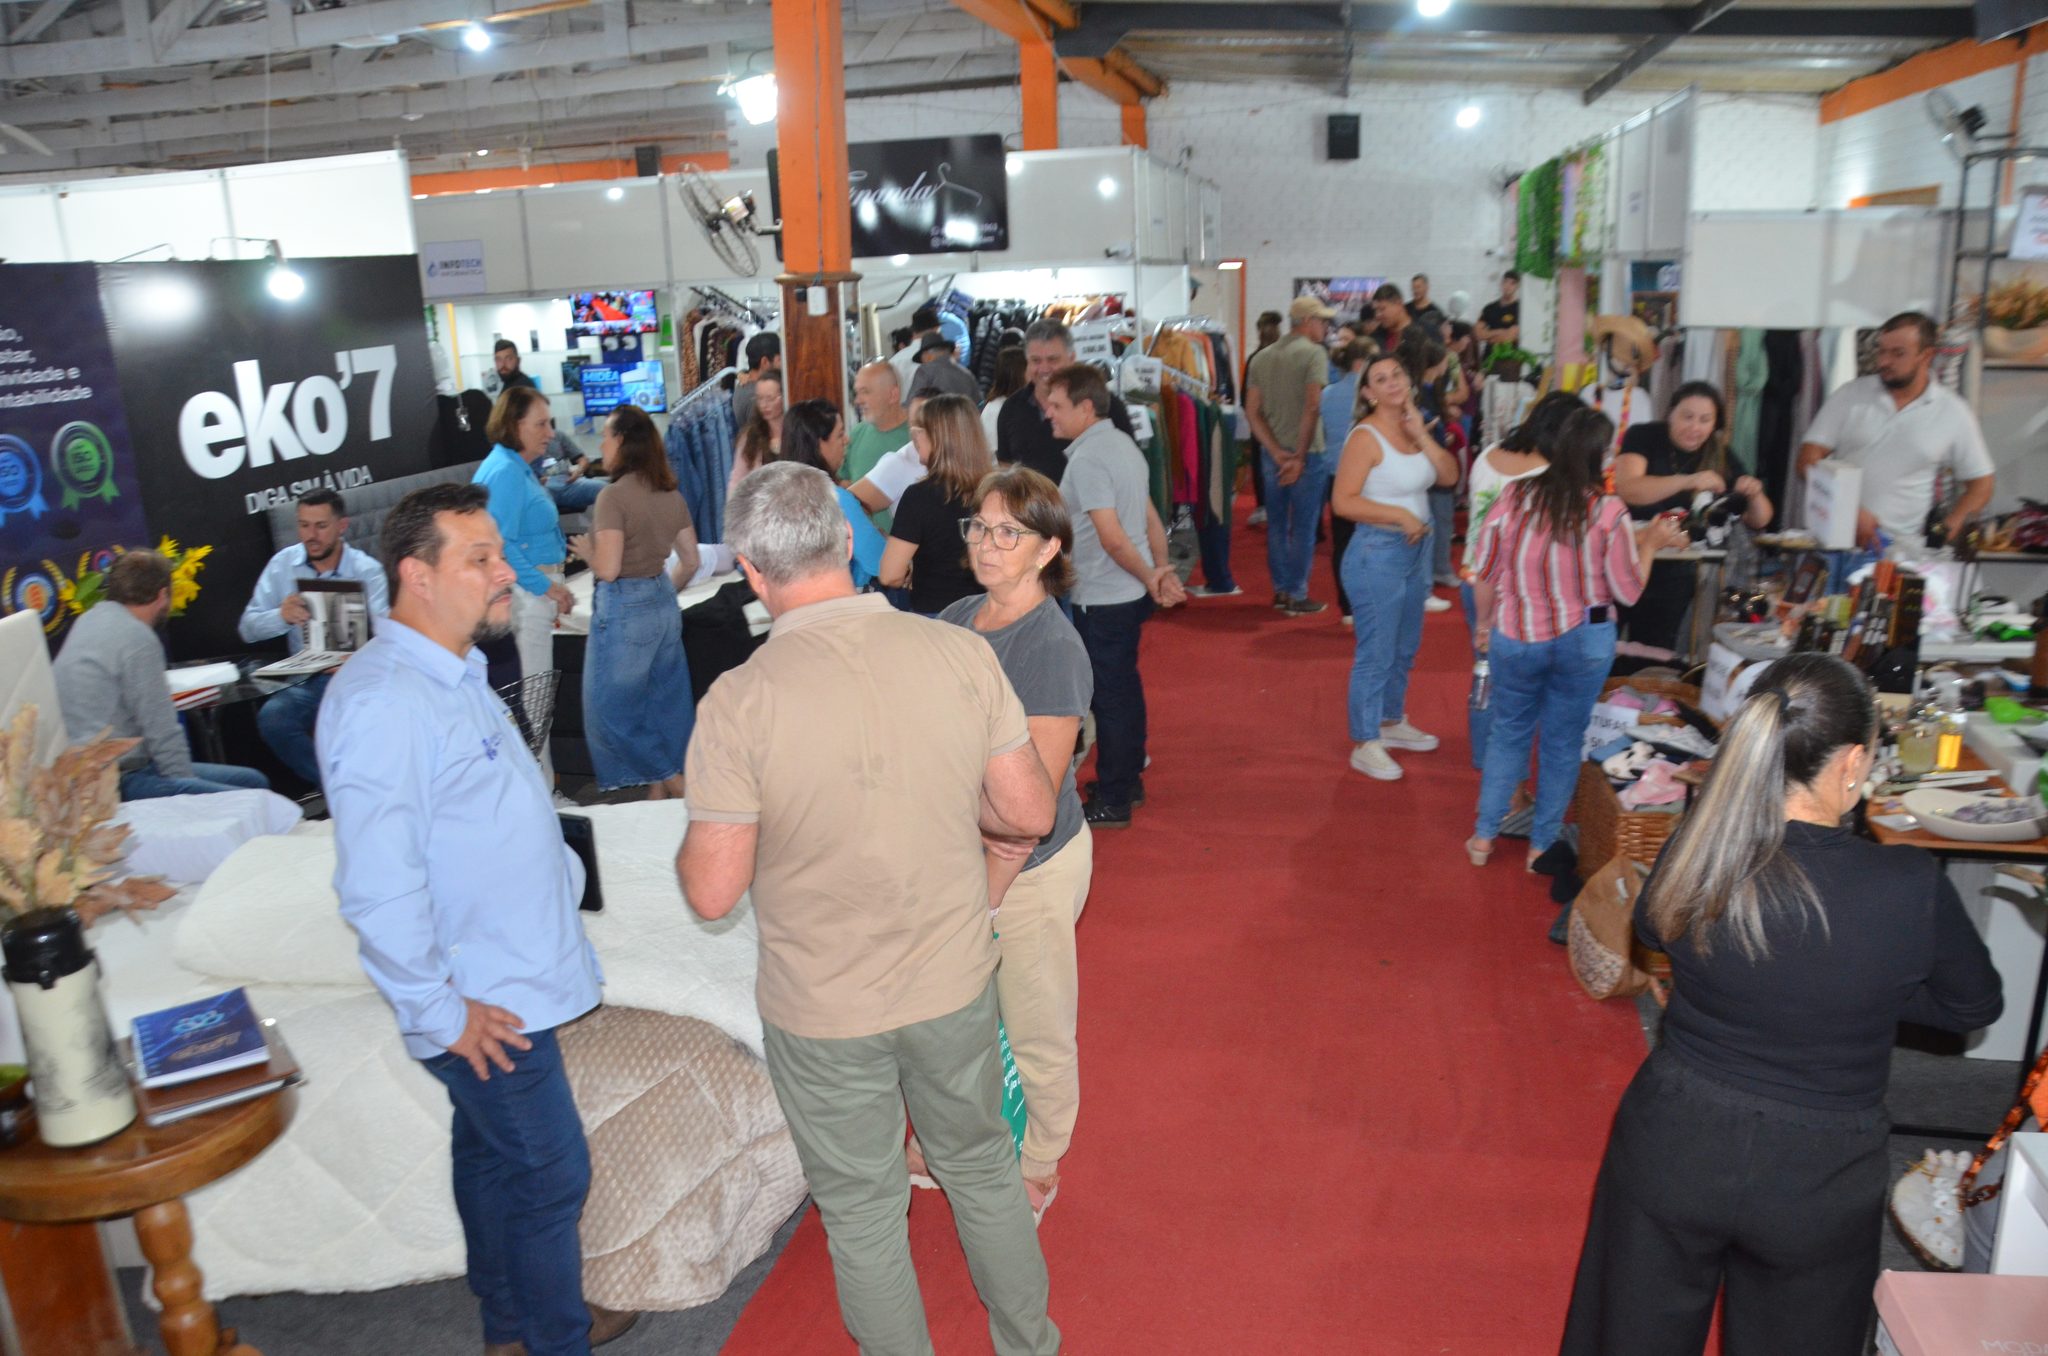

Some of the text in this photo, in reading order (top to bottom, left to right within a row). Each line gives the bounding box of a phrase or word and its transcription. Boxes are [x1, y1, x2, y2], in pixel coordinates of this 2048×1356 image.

[67, 366, 81, 380] e
[245, 485, 290, 515] DIGA
[335, 464, 374, 490] VIDA
